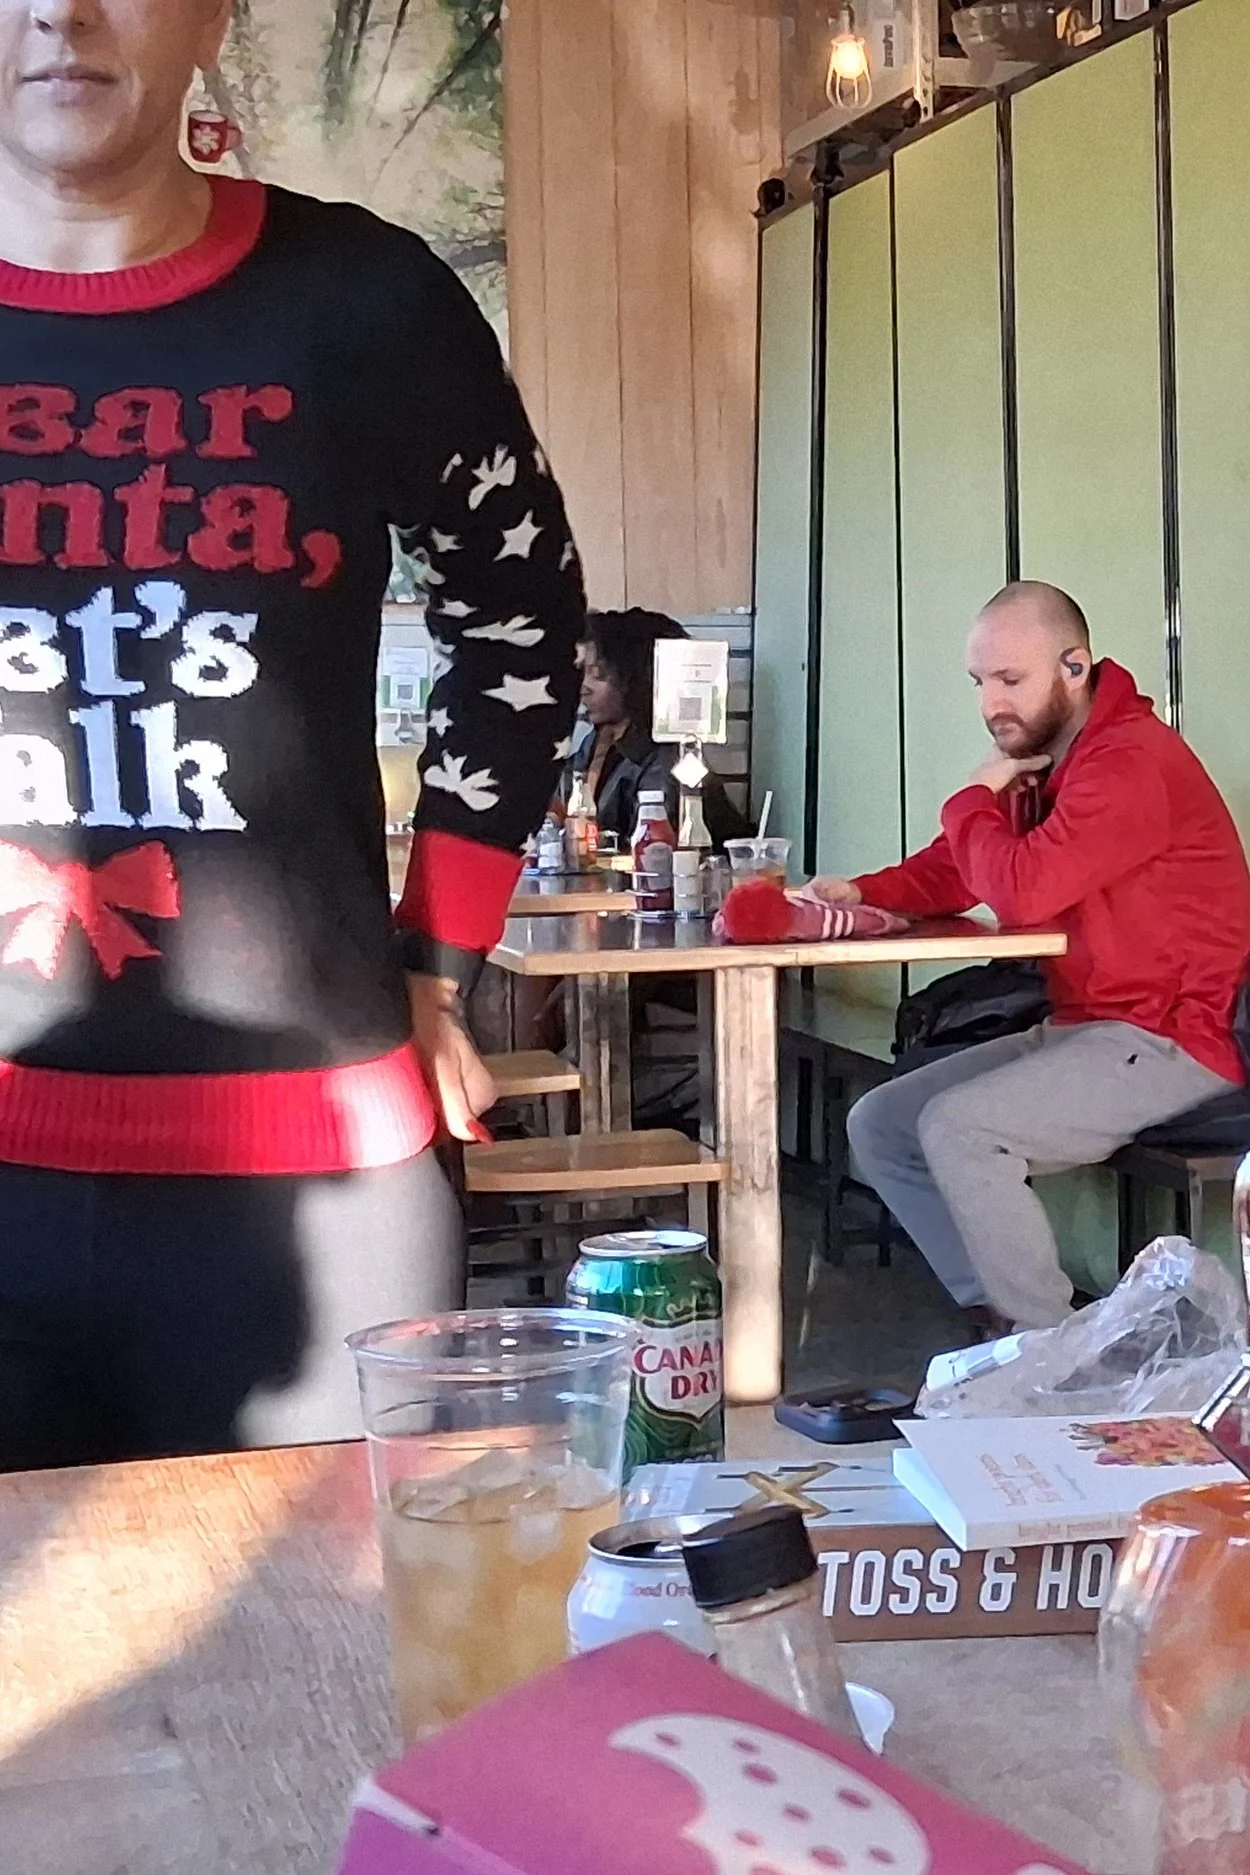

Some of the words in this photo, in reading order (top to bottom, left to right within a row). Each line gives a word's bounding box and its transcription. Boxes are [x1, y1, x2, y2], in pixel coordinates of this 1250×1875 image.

[633, 1338, 722, 1374] CANA
[817, 1548, 961, 1617] TOSS
[979, 1546, 1018, 1612] &
